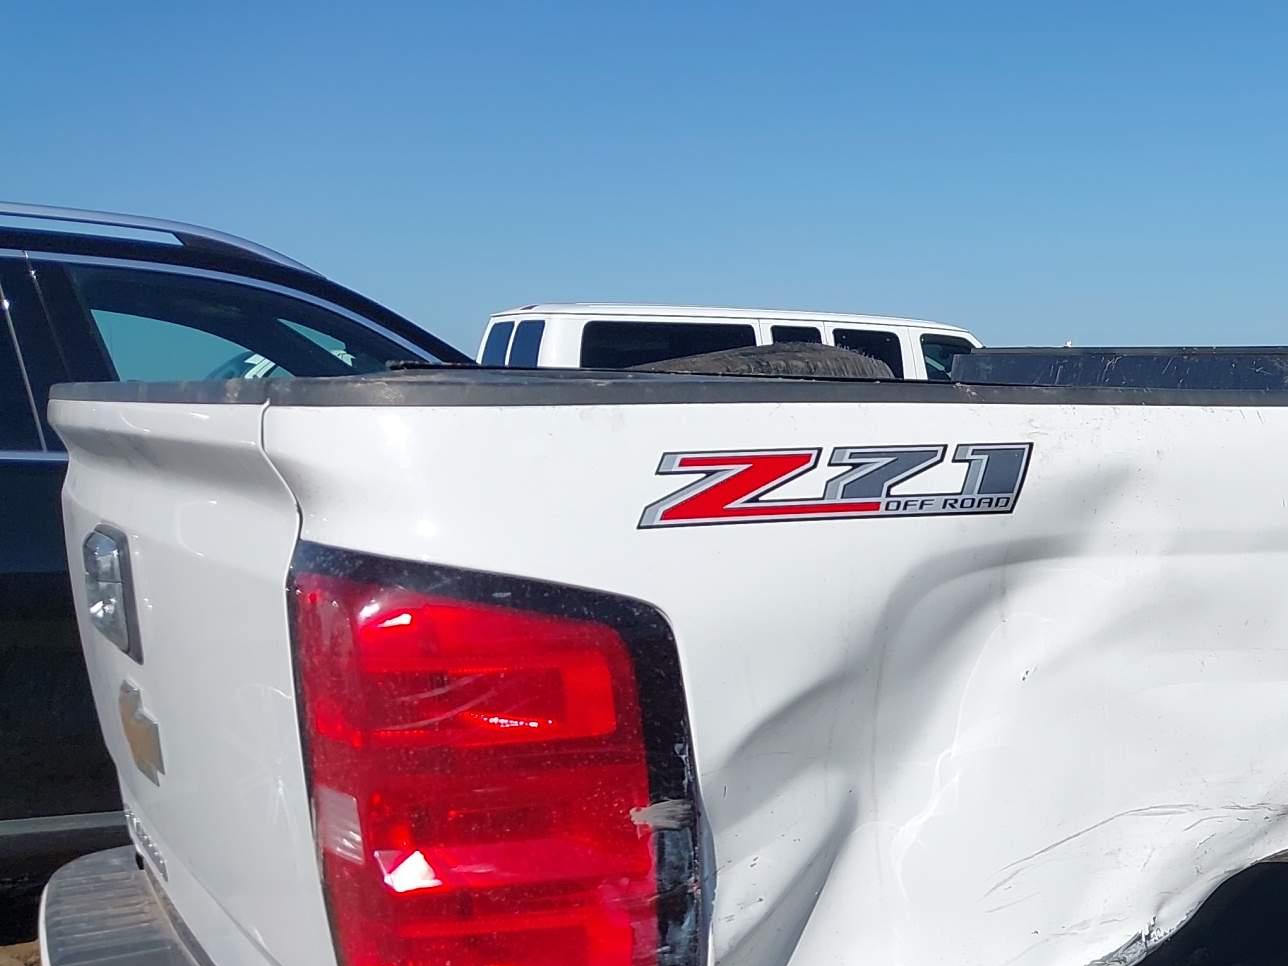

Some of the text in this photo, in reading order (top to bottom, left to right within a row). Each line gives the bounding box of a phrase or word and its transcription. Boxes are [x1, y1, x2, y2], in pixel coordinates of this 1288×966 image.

[636, 442, 1035, 530] Z71
[884, 496, 1011, 512] OFF ROAD
